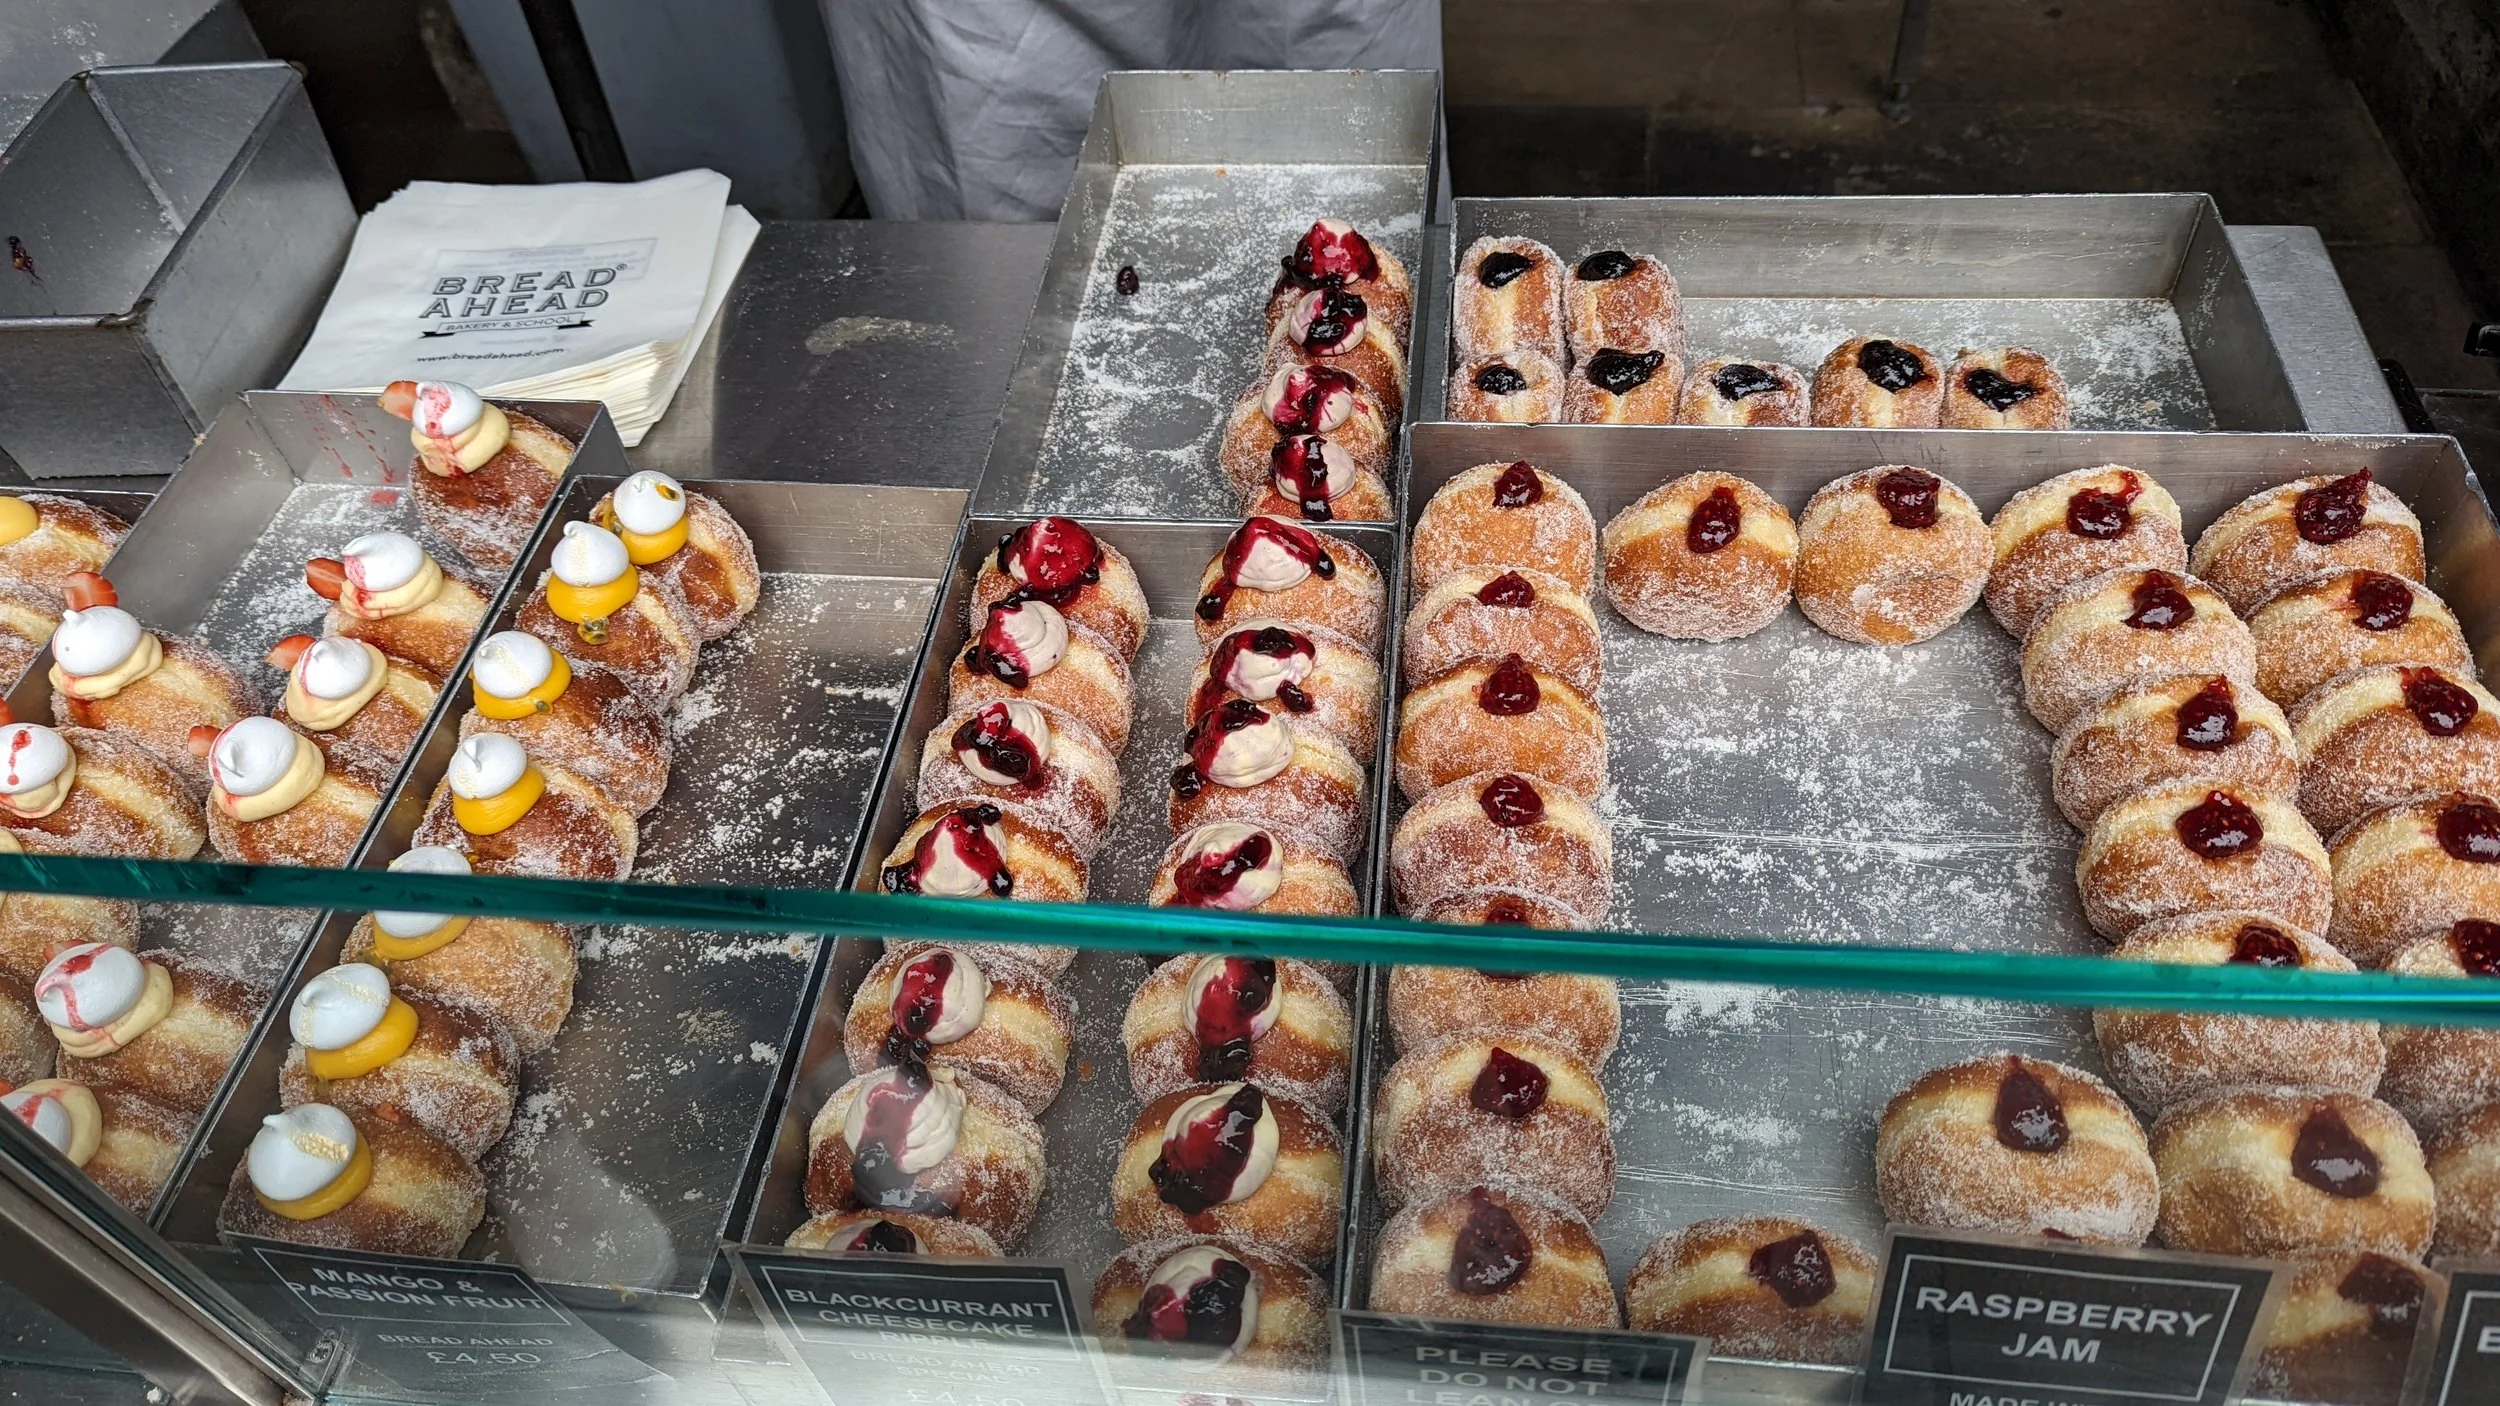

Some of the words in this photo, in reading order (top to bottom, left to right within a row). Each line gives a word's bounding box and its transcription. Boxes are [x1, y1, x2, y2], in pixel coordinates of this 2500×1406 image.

[419, 289, 609, 318] AHEAD
[446, 321, 497, 331] BAKERY
[502, 321, 511, 329] &
[516, 316, 573, 328] SCHOOL
[417, 348, 564, 363] www.breadahead.com
[312, 1267, 444, 1290] MANGO
[456, 1280, 484, 1293] &
[288, 1281, 437, 1307] PASSION
[442, 1294, 546, 1310] FRUIT
[785, 1288, 1053, 1319] BLACKCURRANT
[818, 1308, 1036, 1339] CHEESECAKE
[1915, 1286, 2214, 1337] RASPBERRY
[377, 1334, 462, 1345] BREAD
[470, 1337, 553, 1346] AHEAD
[2001, 1332, 2101, 1364] JAM
[426, 1351, 542, 1364] £4.50
[851, 1350, 942, 1367] BREAD
[950, 1359, 1041, 1377] AHEAD
[1416, 1347, 1612, 1375] PLEASE
[896, 1366, 1011, 1384] SPECIAL
[1420, 1369, 1488, 1387] DO
[1506, 1375, 1608, 1396] NOT
